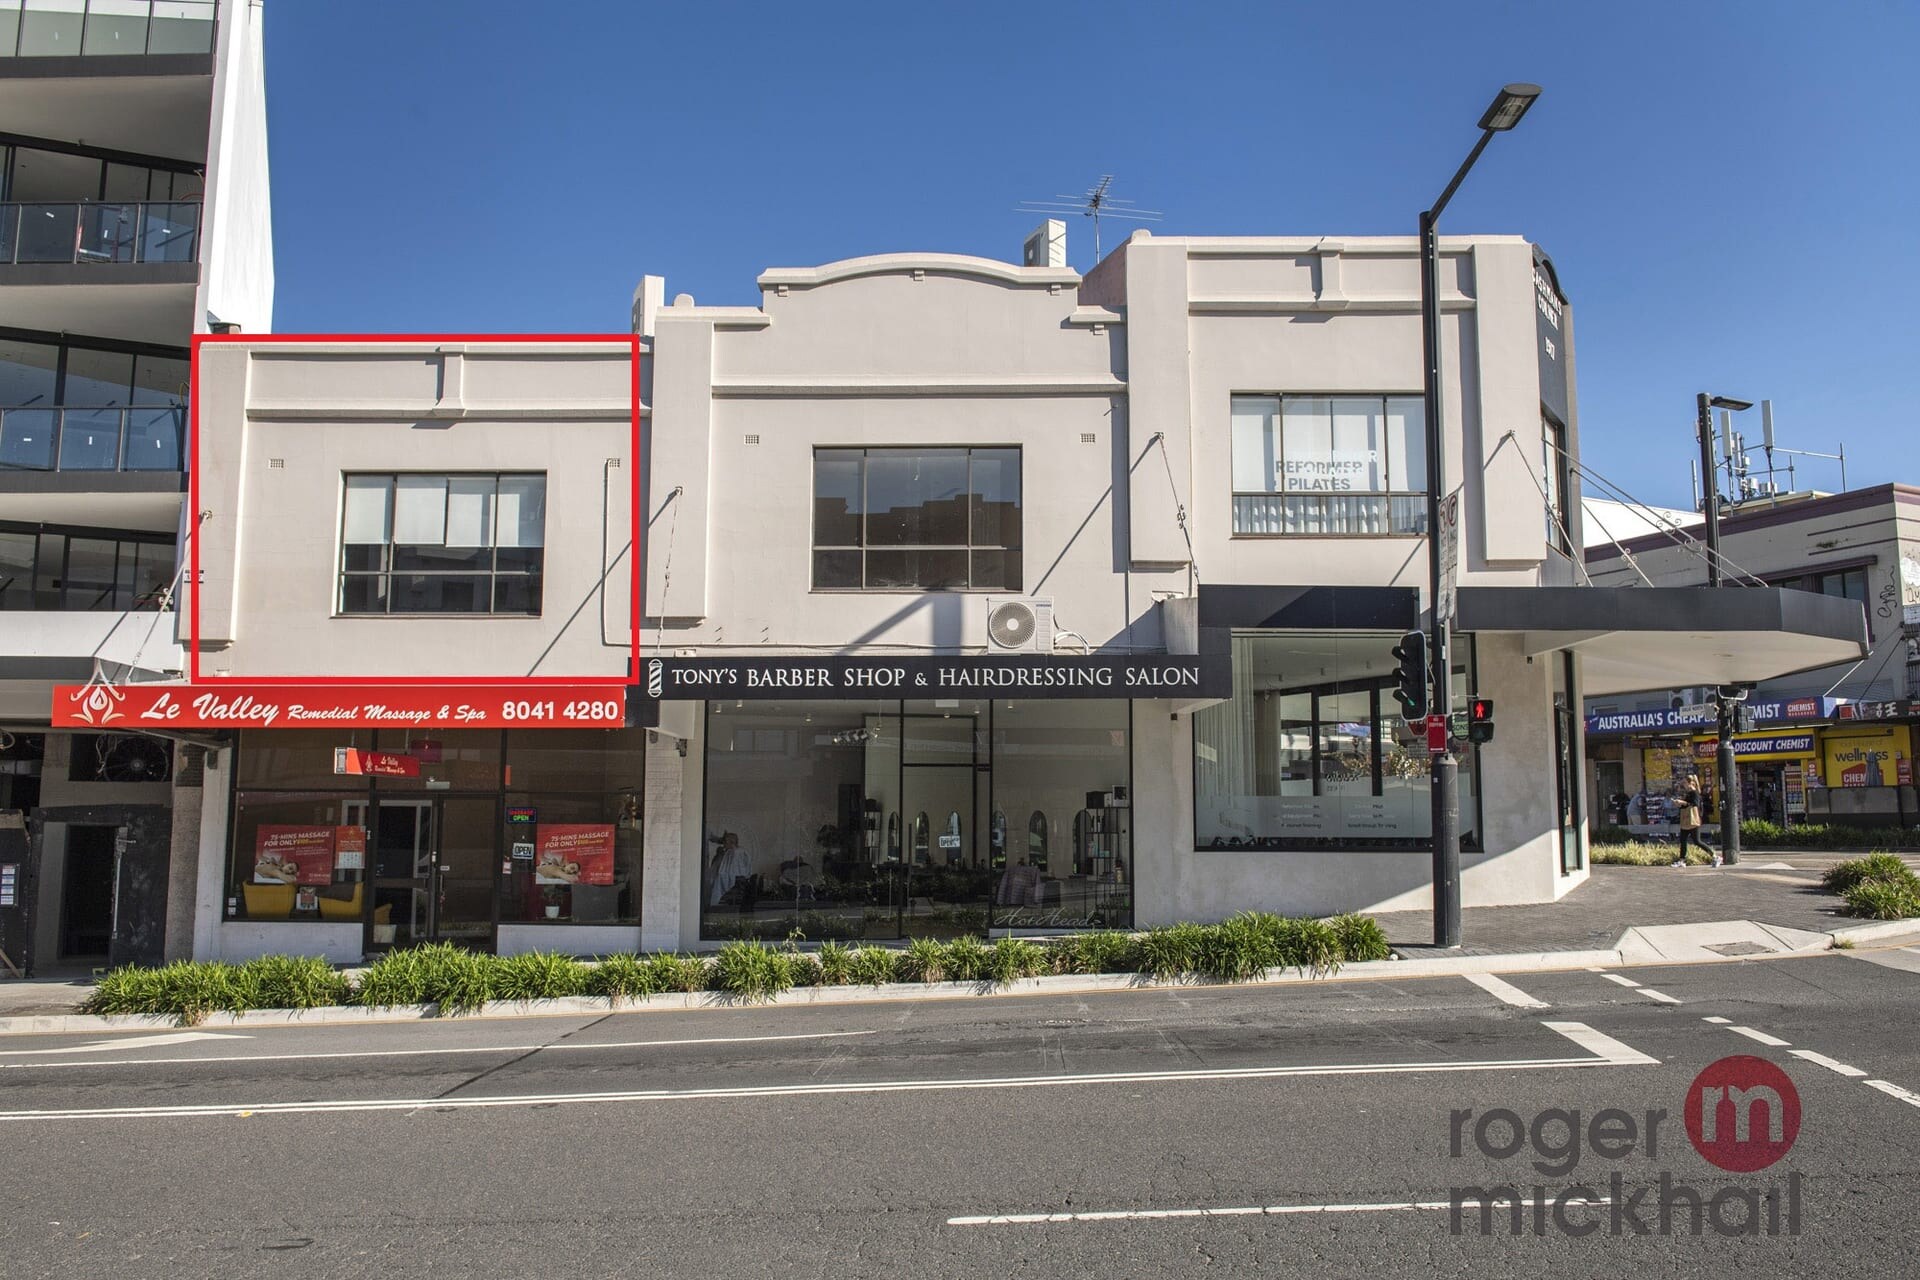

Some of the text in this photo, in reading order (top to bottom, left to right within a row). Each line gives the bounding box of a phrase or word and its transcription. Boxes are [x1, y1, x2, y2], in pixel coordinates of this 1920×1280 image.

[1288, 478, 1351, 490] PILATES
[671, 667, 1200, 687] TONY'S BARBER SHOP & HAIRDRESSING SALON
[140, 692, 619, 727] Le Valley Remedial Massage & Spa 8041 4280
[1787, 702, 1816, 712] CHEMIST
[1598, 712, 1663, 730] AUSTRALIA'S
[1667, 711, 1718, 726] CHEAP
[1752, 703, 1781, 719] MIST
[1734, 738, 1811, 753] DISCOUNT CHEMIST
[1835, 748, 1889, 763] wellnss
[298, 831, 330, 839] MASSAGE
[578, 831, 610, 839] MASSAGE
[514, 845, 532, 855] OPEN
